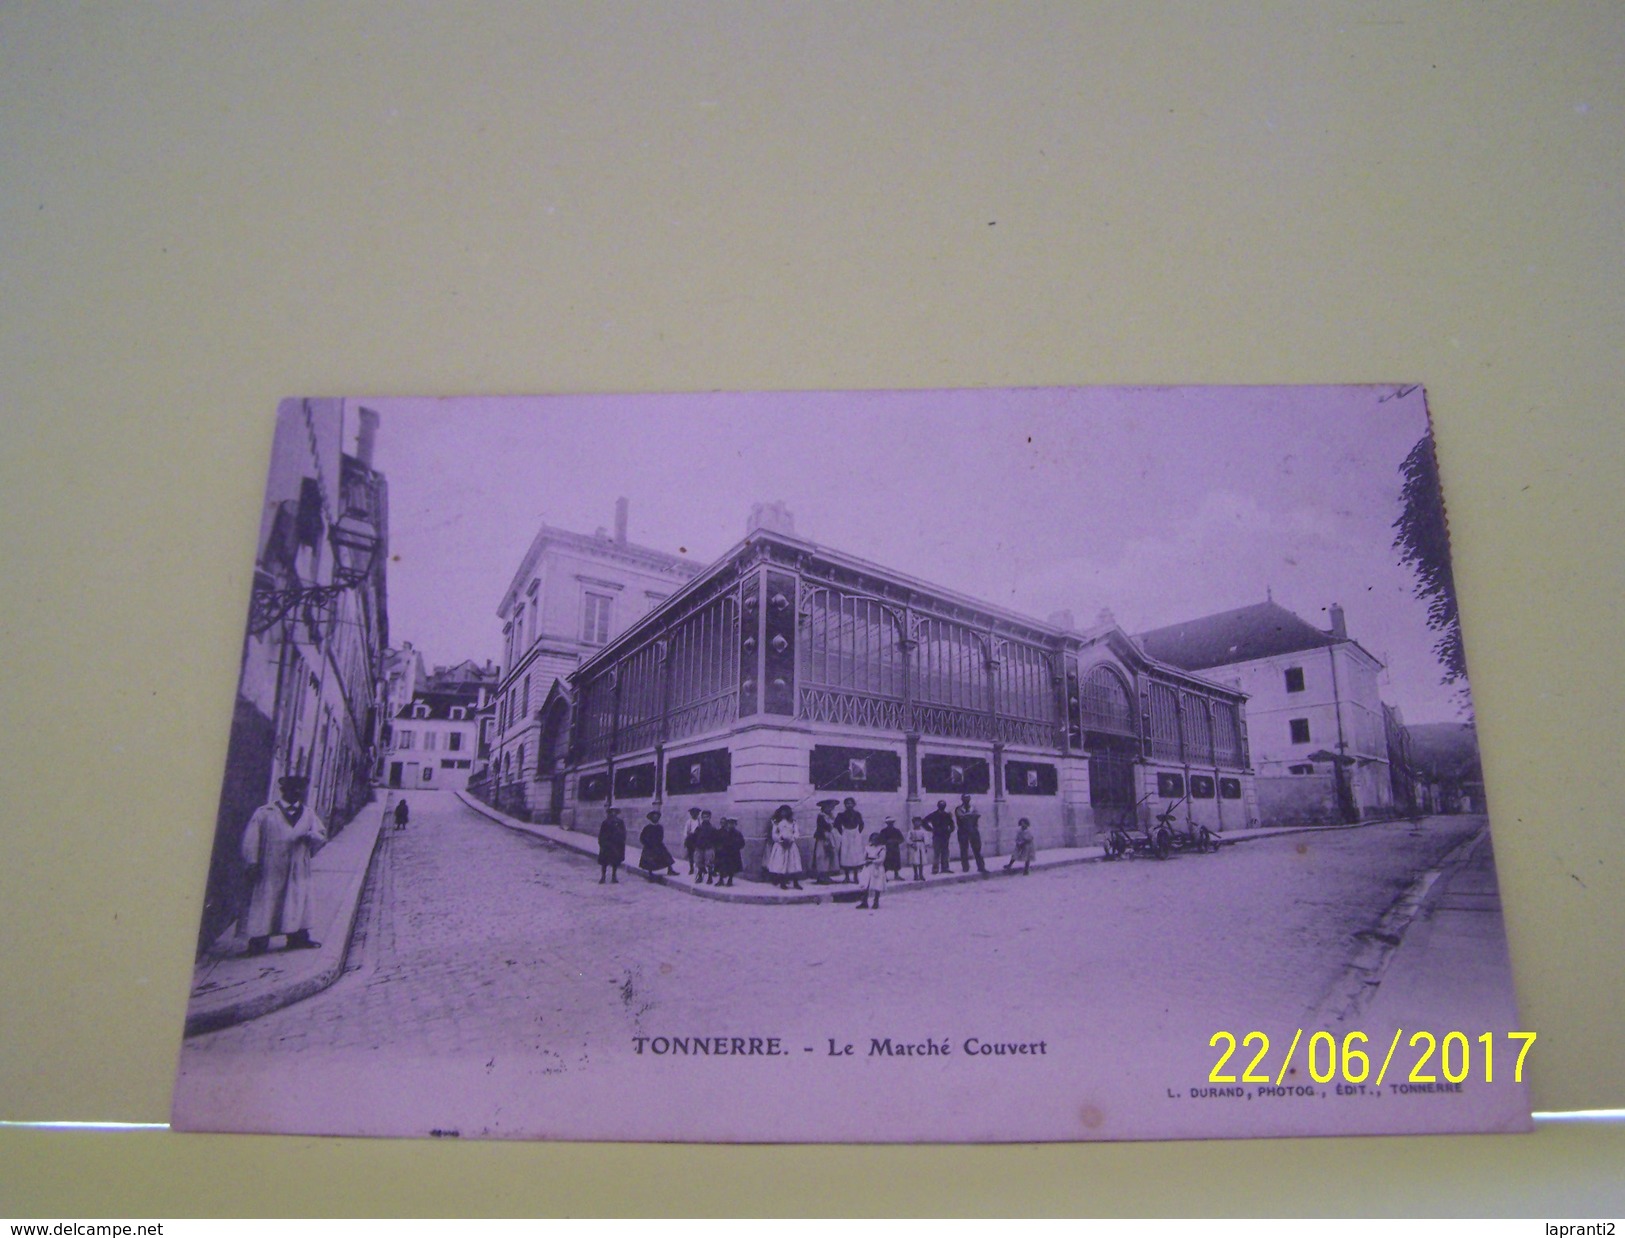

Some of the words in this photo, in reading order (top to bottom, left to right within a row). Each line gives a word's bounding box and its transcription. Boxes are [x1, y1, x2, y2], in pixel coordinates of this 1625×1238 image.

[632, 1037, 789, 1056] TONNERRE.
[828, 1038, 854, 1056] Le
[868, 1037, 950, 1056] Marché
[964, 1038, 1047, 1056] Couvert
[1167, 1088, 1181, 1098] L.
[1190, 1086, 1252, 1100] DURAND,
[1391, 1083, 1463, 1095] TONNERRE
